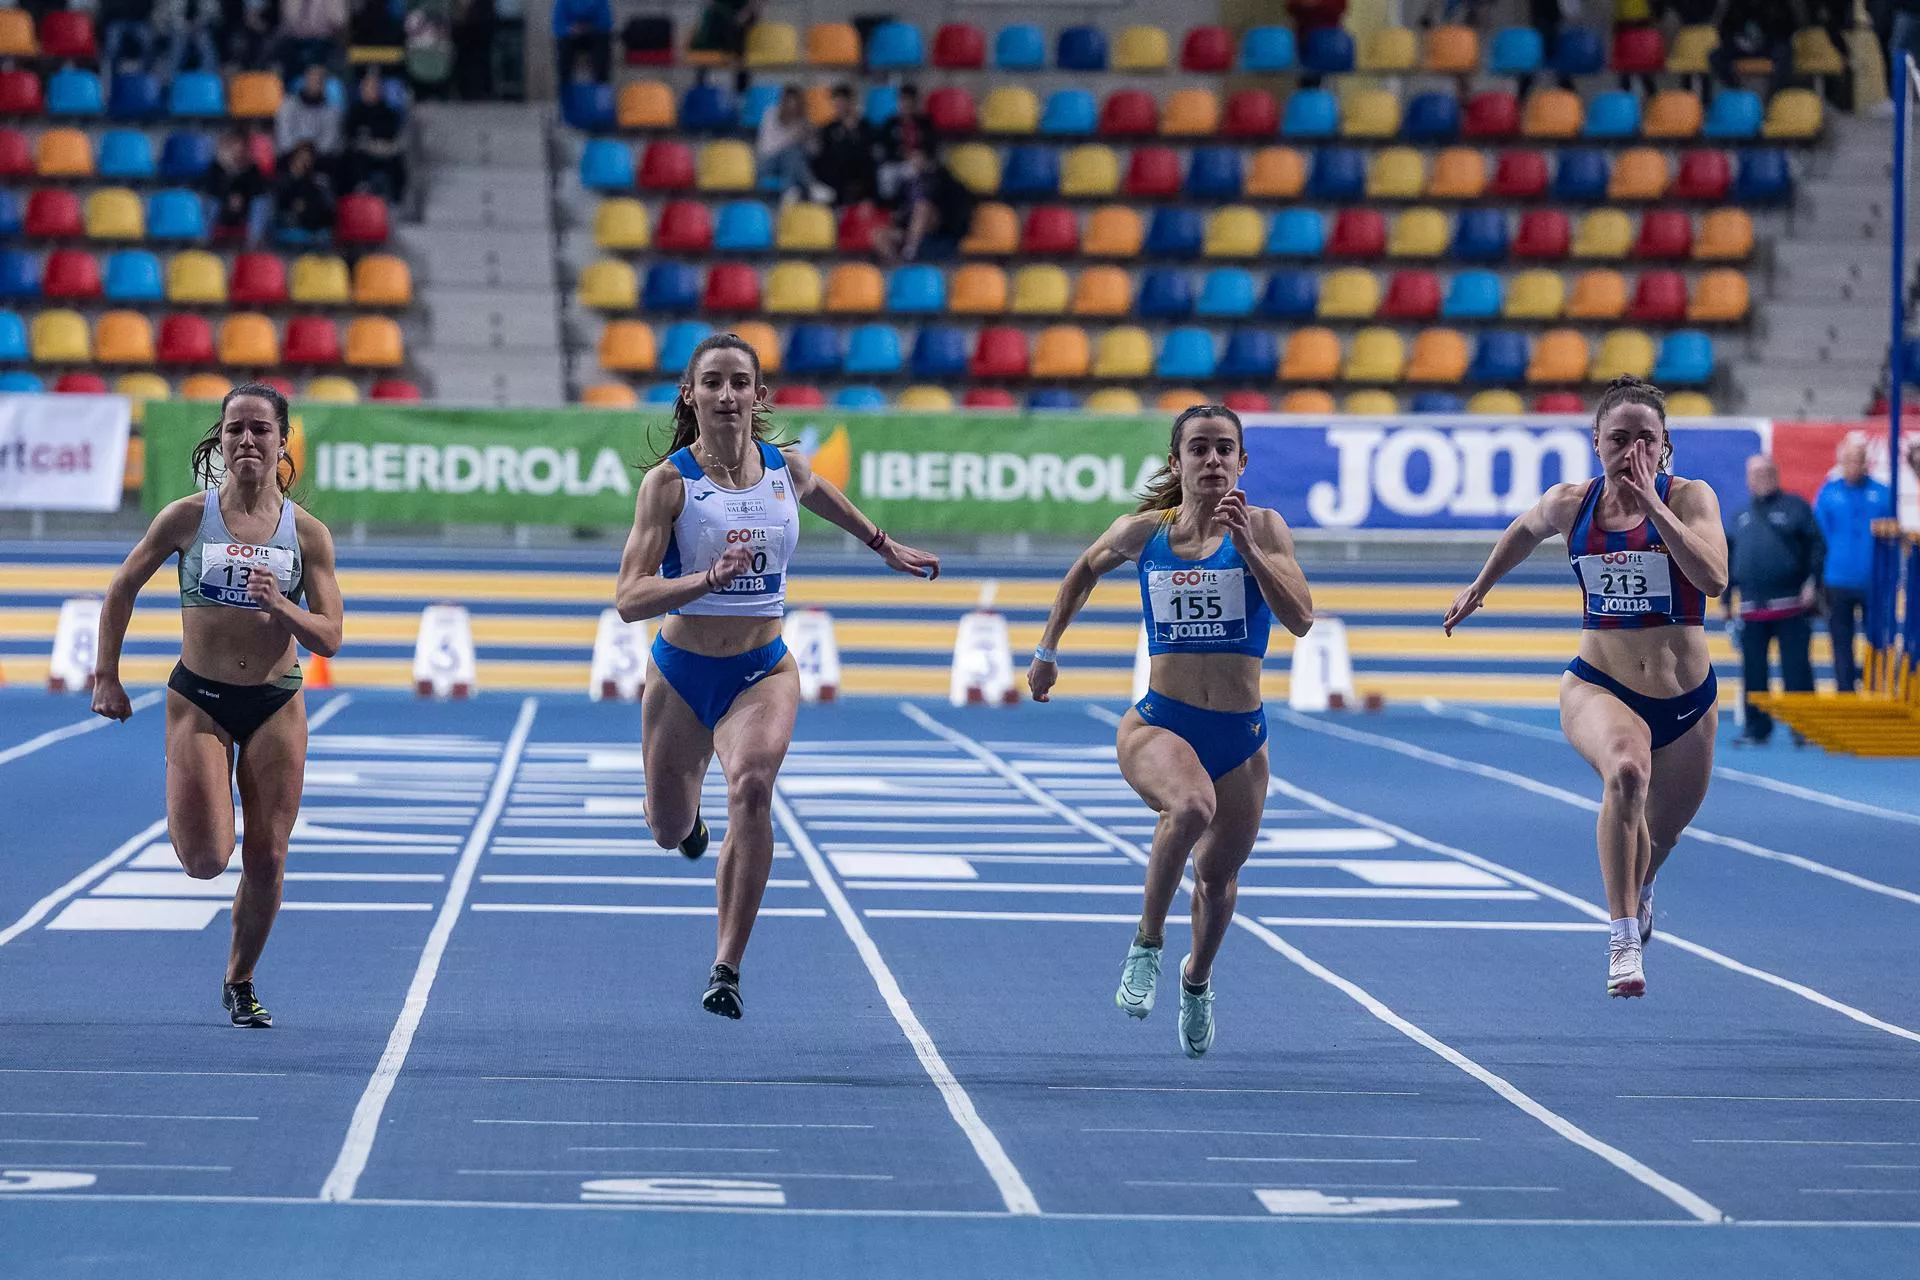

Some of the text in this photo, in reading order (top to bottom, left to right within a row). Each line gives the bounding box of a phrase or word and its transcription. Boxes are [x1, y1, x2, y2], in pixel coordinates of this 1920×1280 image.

[316, 443, 632, 496] IBERDROLA
[1307, 425, 1592, 526] Jom
[727, 505, 764, 513] VALENCIA
[727, 528, 766, 544] GOfit
[226, 544, 270, 558] GOfit
[1602, 552, 1643, 565] GOfit
[222, 565, 253, 588] 13
[1171, 571, 1218, 586] GOfit
[1600, 573, 1648, 596] 213
[1169, 596, 1223, 620] 155
[1601, 597, 1652, 612] Joma
[1169, 622, 1227, 640] Joma
